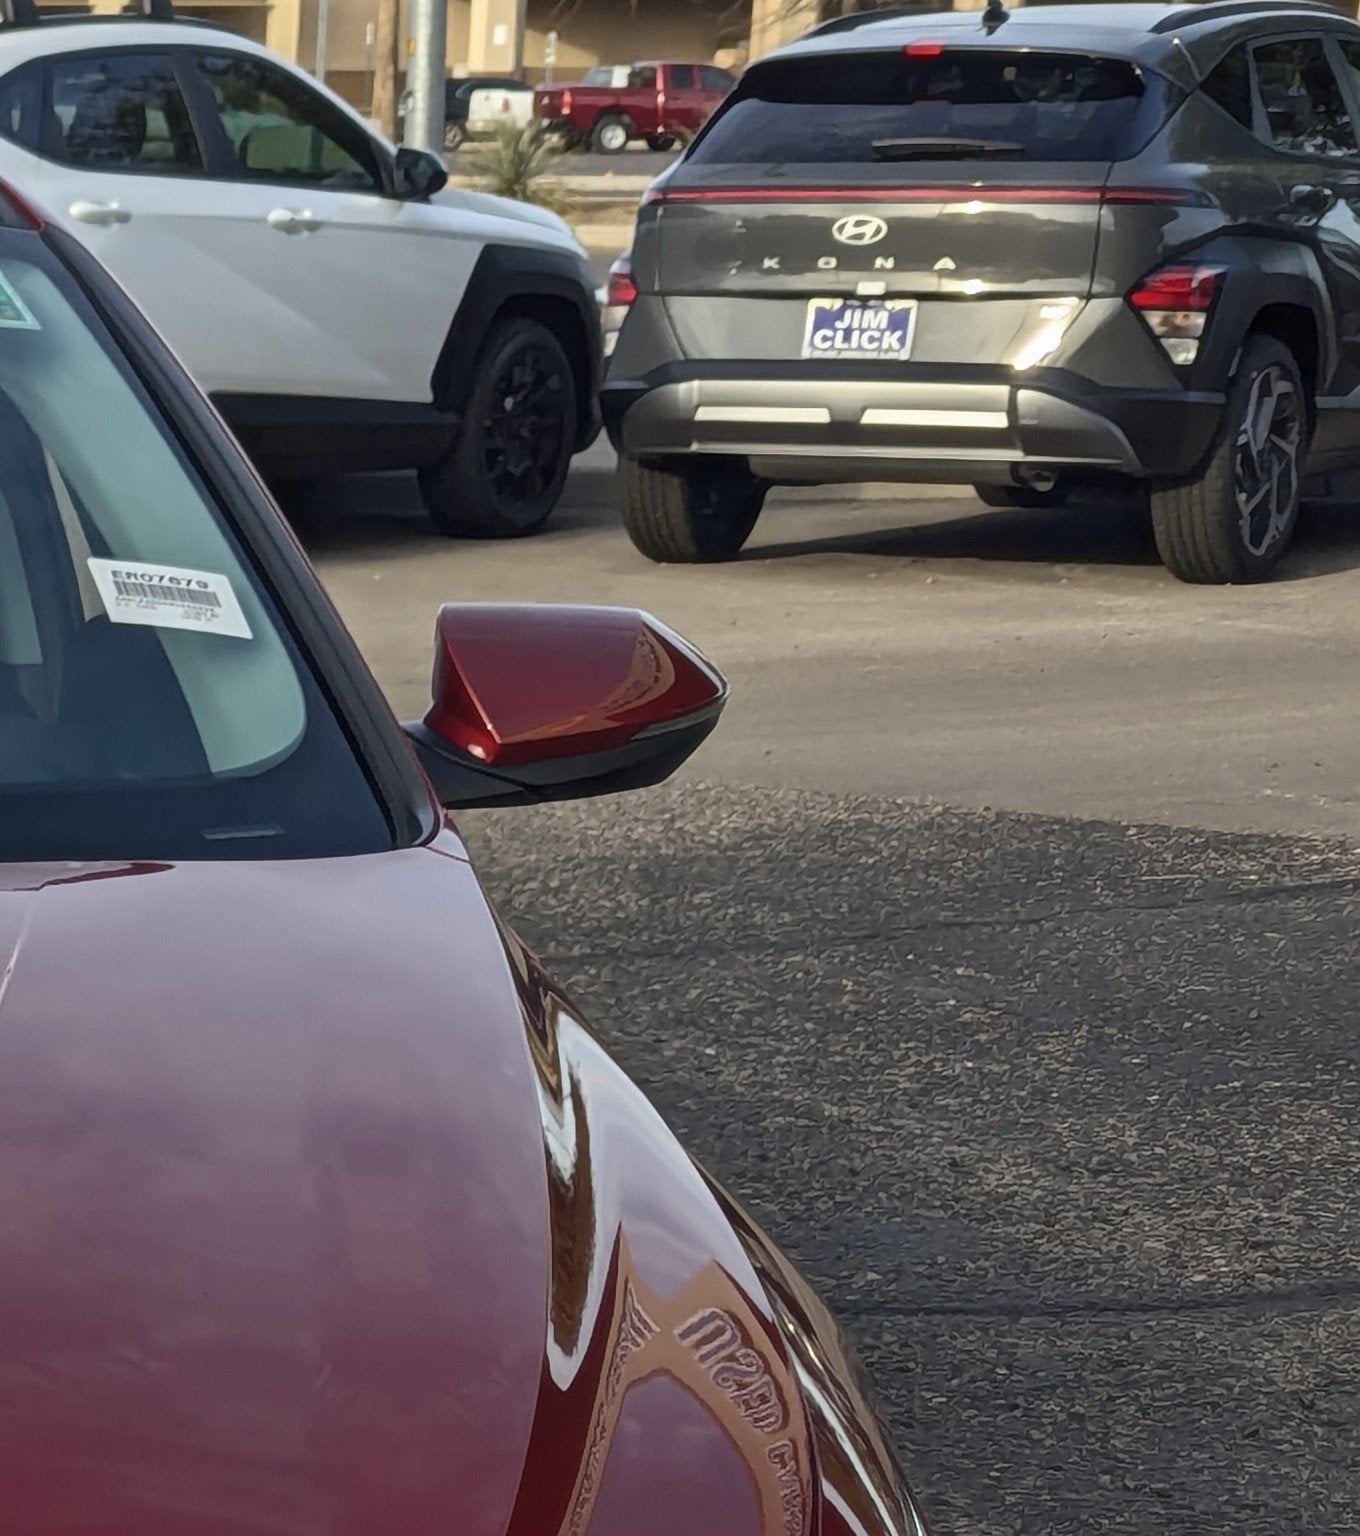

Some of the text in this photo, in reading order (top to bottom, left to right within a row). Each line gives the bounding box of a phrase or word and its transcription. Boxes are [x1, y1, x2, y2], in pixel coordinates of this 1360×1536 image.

[762, 256, 957, 270] KONA
[834, 308, 890, 329] JIM
[813, 329, 904, 350] CLICK
